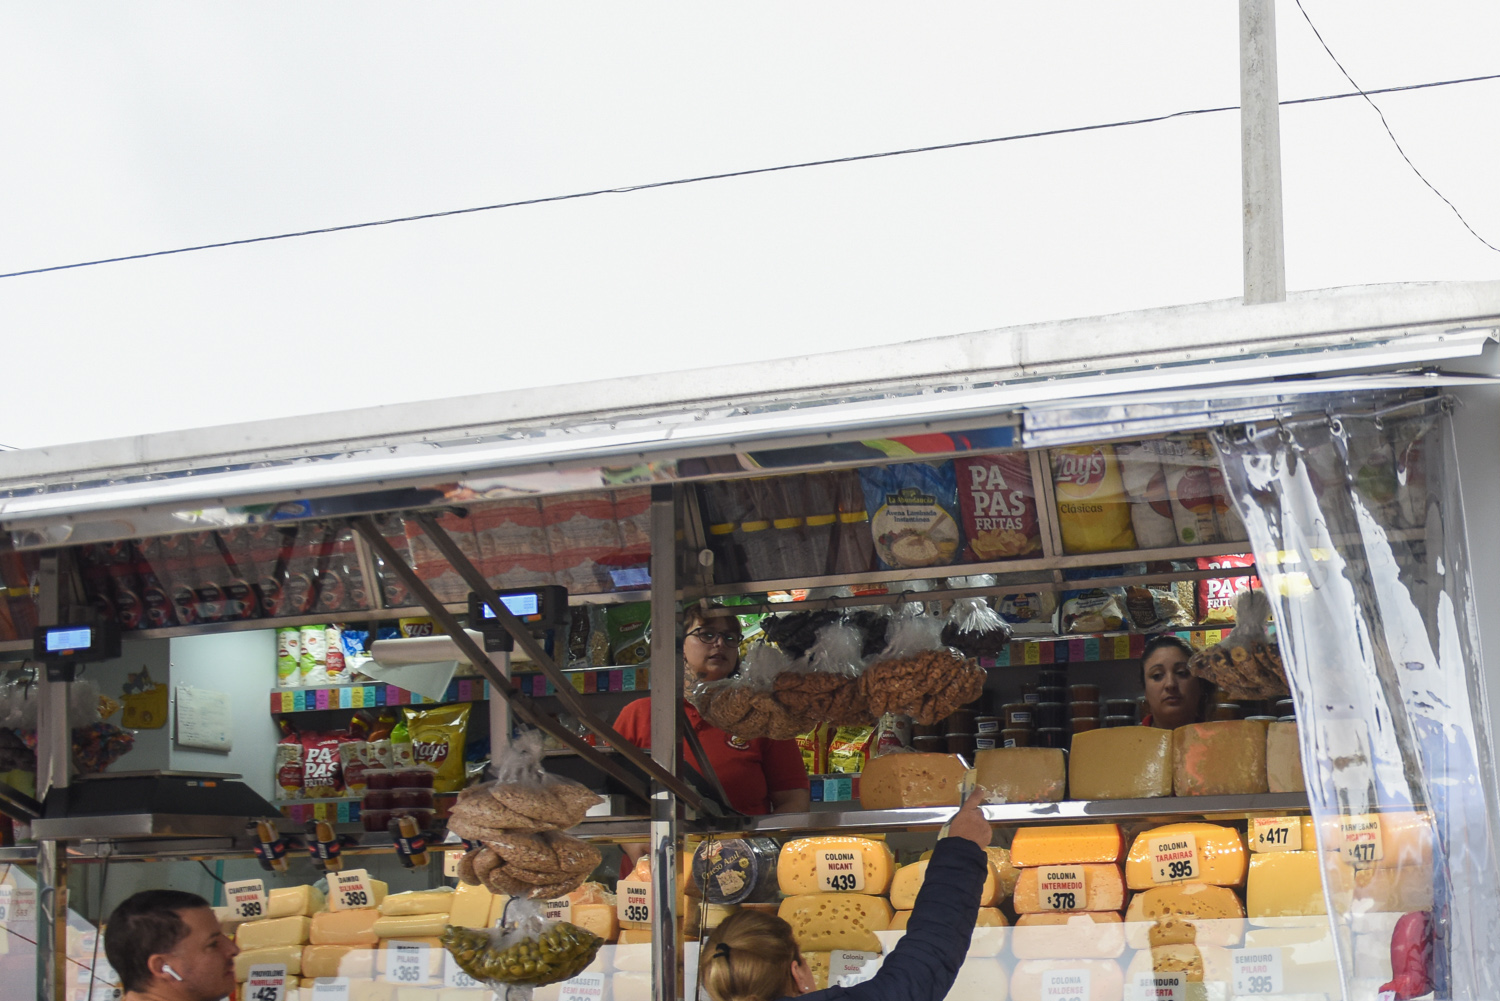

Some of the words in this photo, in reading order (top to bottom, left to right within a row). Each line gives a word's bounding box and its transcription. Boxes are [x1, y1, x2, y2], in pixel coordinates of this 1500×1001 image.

[968, 465, 1008, 490] PA
[971, 490, 1026, 516] PAS
[1060, 503, 1102, 514] Clásicas
[974, 518, 1023, 530] FRITAS
[1207, 578, 1248, 599] PAS
[1208, 598, 1233, 609] FRIT
[308, 748, 332, 763] PA
[304, 762, 339, 778] PAS
[304, 778, 334, 788] FRITAS
[1158, 841, 1188, 852] COLONIA
[1155, 850, 1192, 862] TARARIRAS
[702, 864, 722, 880] Queso
[724, 850, 740, 866] Azul
[339, 884, 364, 892] SILVANA
[826, 874, 856, 891] $439
[1042, 882, 1082, 890] INTERMEDIO
[1048, 892, 1075, 908] $378
[625, 906, 649, 921] $359
[1235, 954, 1273, 964] SEMIDURO
[1241, 965, 1267, 974] PILARO
[1140, 978, 1179, 987] SEMIDURO
[579, 987, 600, 996] MAGRO
[1048, 986, 1084, 995] VALDENSE
